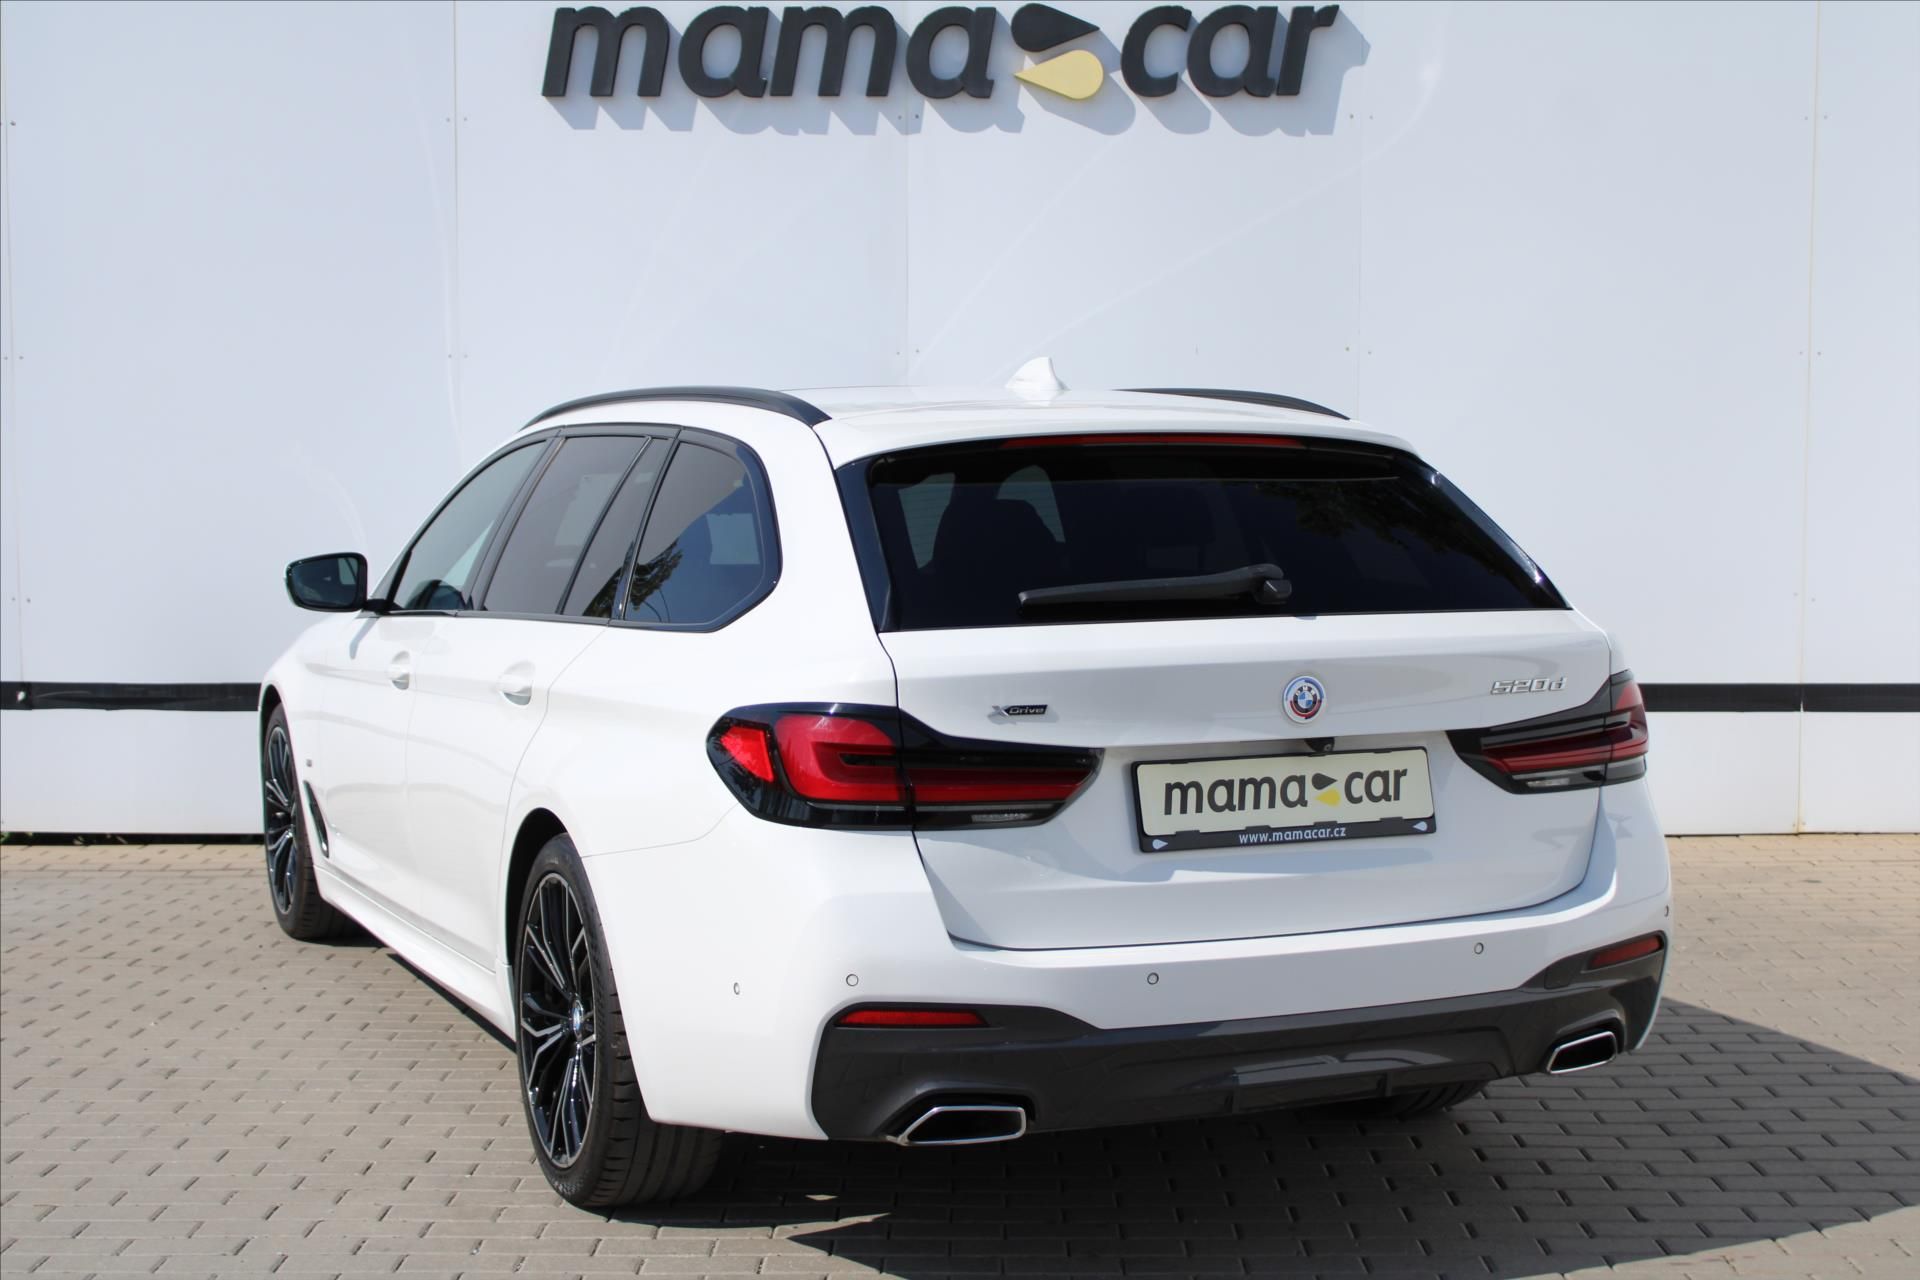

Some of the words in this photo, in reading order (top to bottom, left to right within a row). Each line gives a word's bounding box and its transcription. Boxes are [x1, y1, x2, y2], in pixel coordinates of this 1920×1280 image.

[541, 6, 997, 98] mama
[1120, 5, 1340, 98] car
[1490, 677, 1567, 695] 520d
[1164, 774, 1308, 815] mama
[1343, 768, 1408, 804] car
[1239, 827, 1347, 844] www.mamacar.cz
